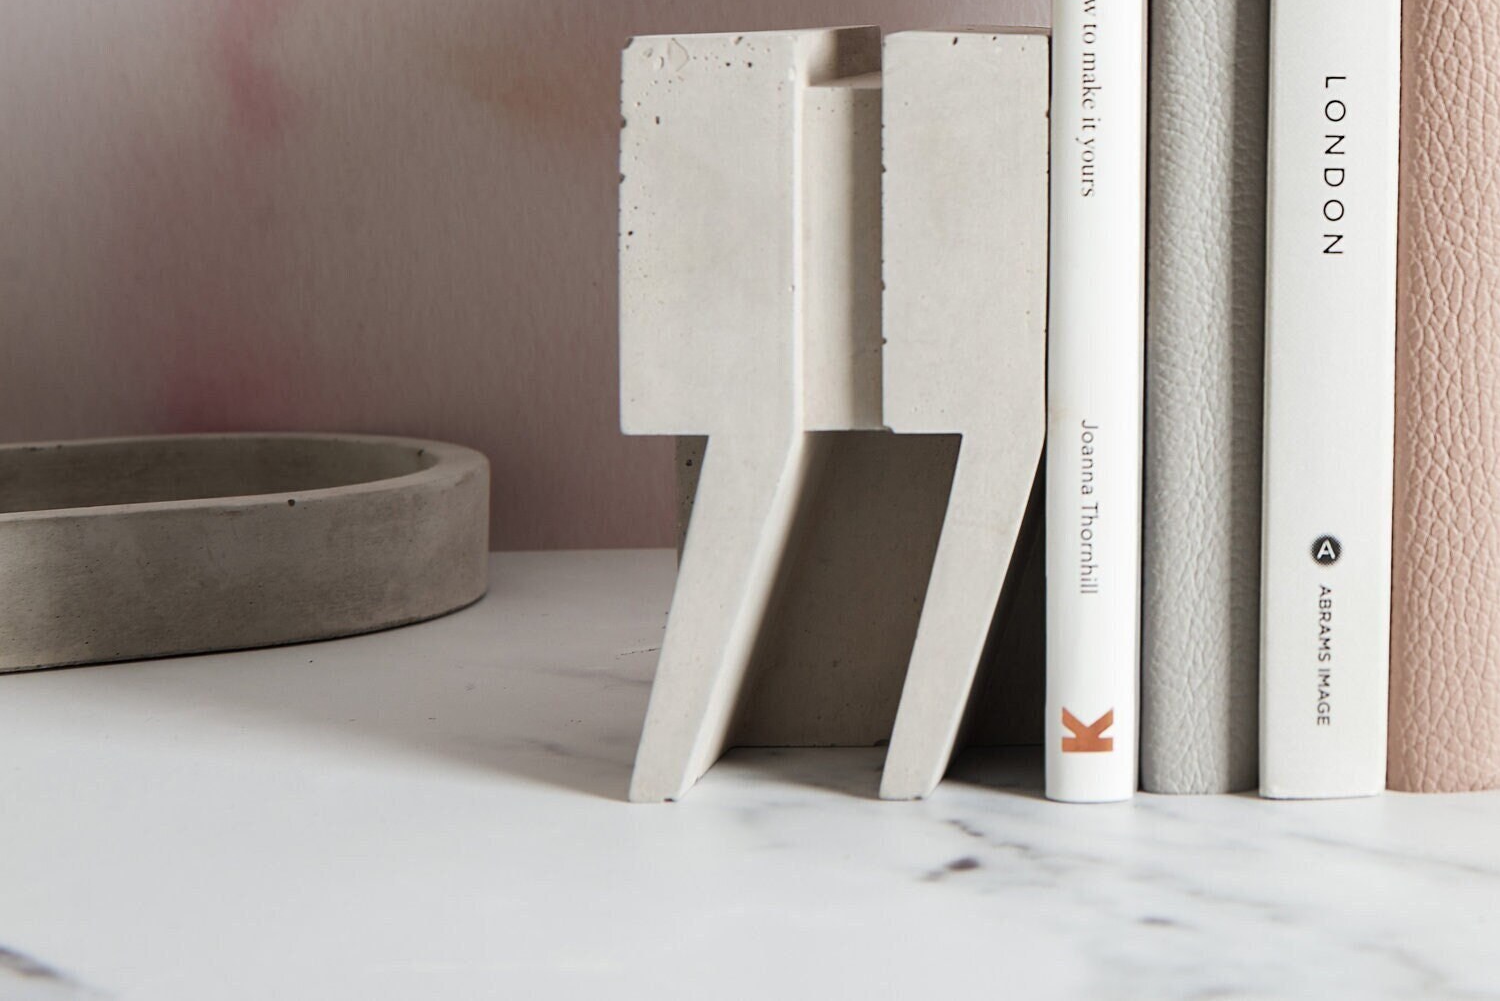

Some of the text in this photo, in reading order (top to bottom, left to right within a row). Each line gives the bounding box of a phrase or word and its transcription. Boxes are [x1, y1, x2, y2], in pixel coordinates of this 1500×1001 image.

[1083, 24, 1099, 44] to
[1082, 53, 1102, 109] make
[1081, 117, 1101, 130] it
[1075, 137, 1096, 197] yours
[1323, 75, 1347, 255] LONDON
[1080, 419, 1099, 593] Joanna Thornhill
[1316, 584, 1332, 726] ABRAMS IMAGE
